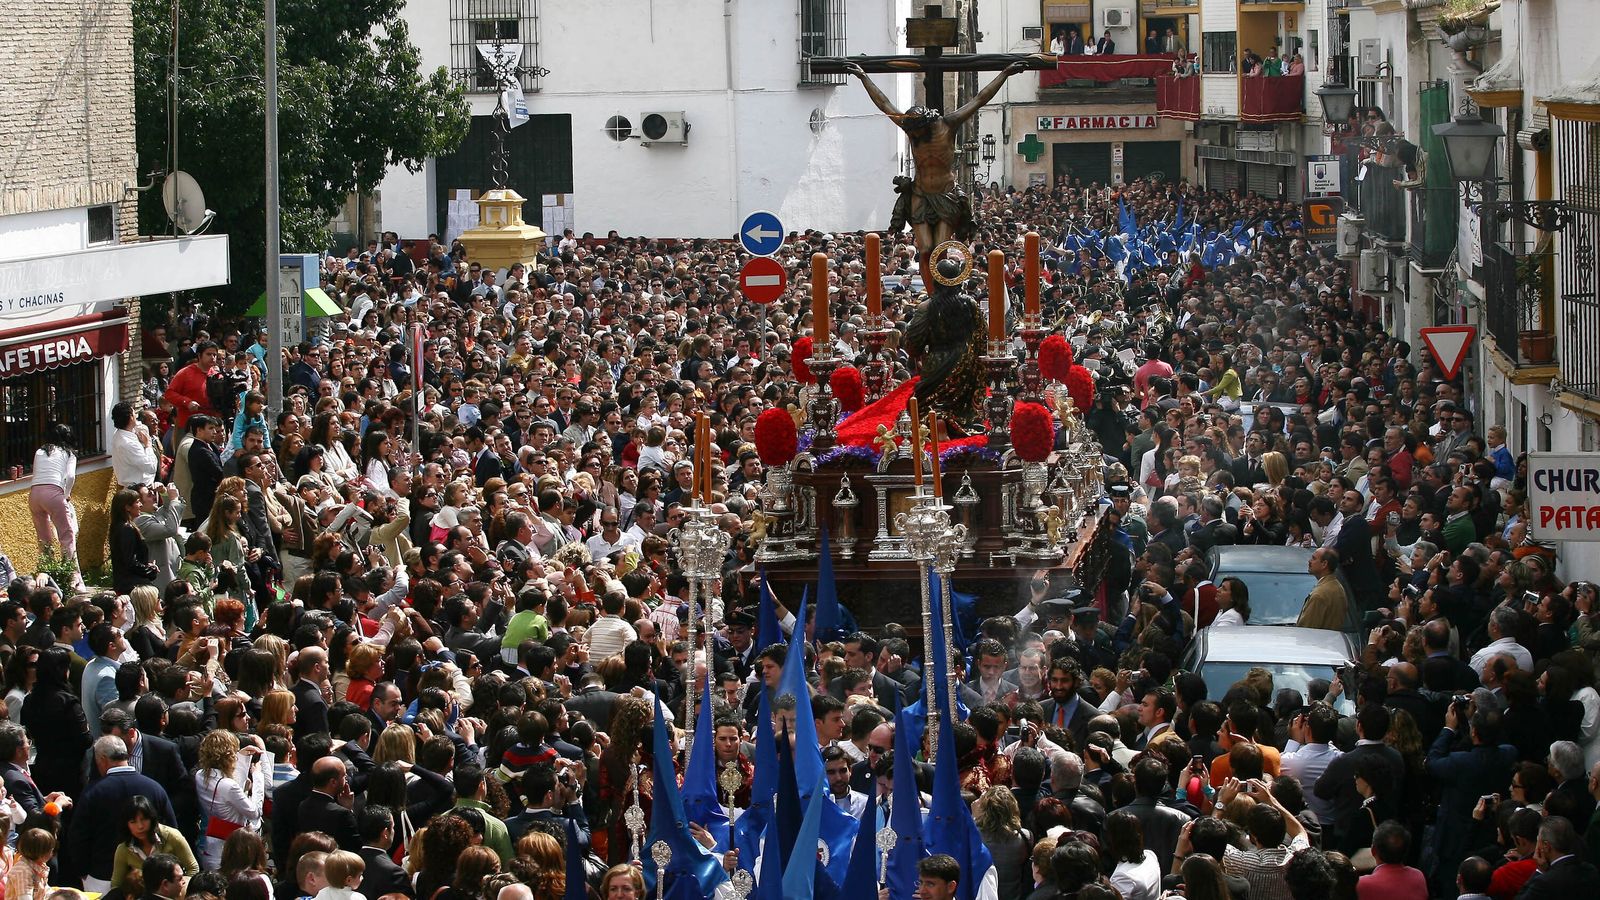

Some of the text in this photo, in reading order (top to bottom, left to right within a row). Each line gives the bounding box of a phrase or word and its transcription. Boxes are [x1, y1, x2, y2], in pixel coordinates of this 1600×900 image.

[1053, 116, 1156, 129] FARMACIA
[8, 299, 14, 310] Y
[19, 292, 64, 309] CHACINAS
[284, 317, 292, 329] DE
[284, 332, 292, 343] LA
[1534, 469, 1600, 494] CHUR
[1539, 506, 1600, 531] PATA
